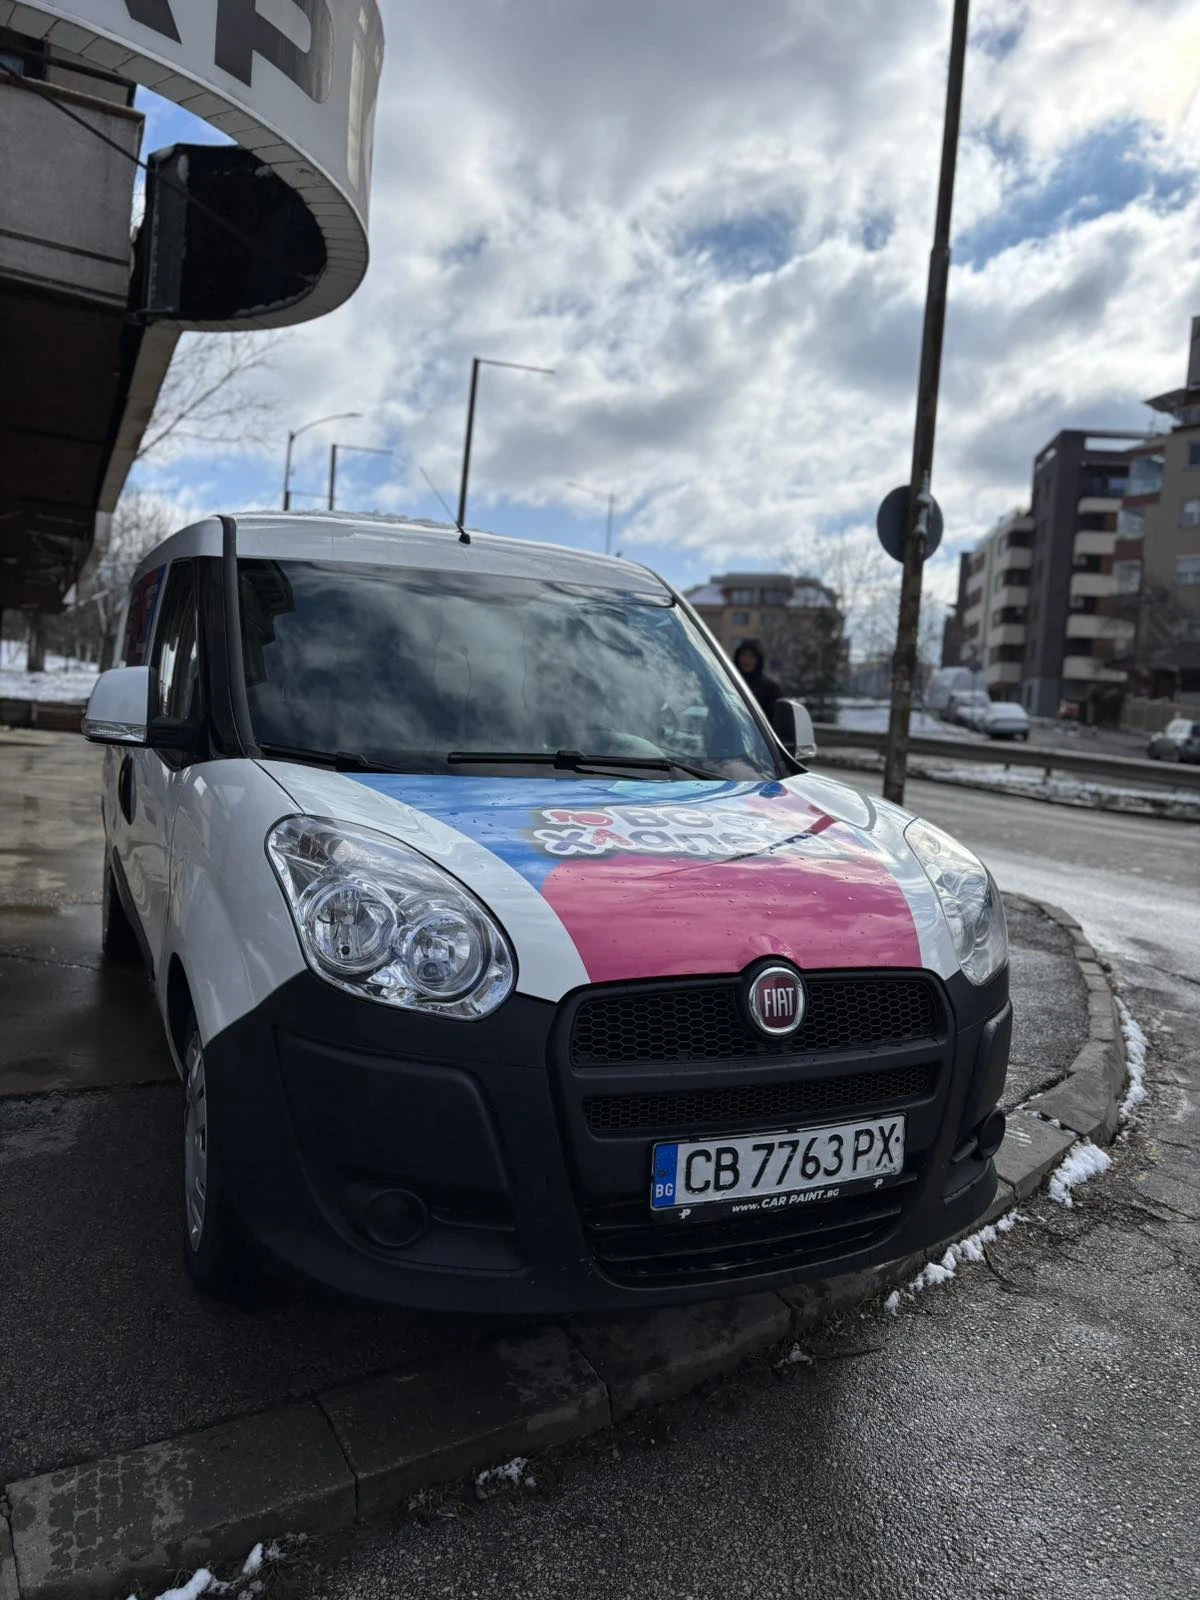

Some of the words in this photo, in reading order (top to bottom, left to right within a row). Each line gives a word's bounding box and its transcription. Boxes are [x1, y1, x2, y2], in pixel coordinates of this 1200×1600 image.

[763, 987, 795, 1018] FIAT
[655, 1182, 674, 1198] BG
[684, 1145, 741, 1195] CB
[750, 1133, 845, 1188] 7763
[851, 1122, 898, 1171] PX
